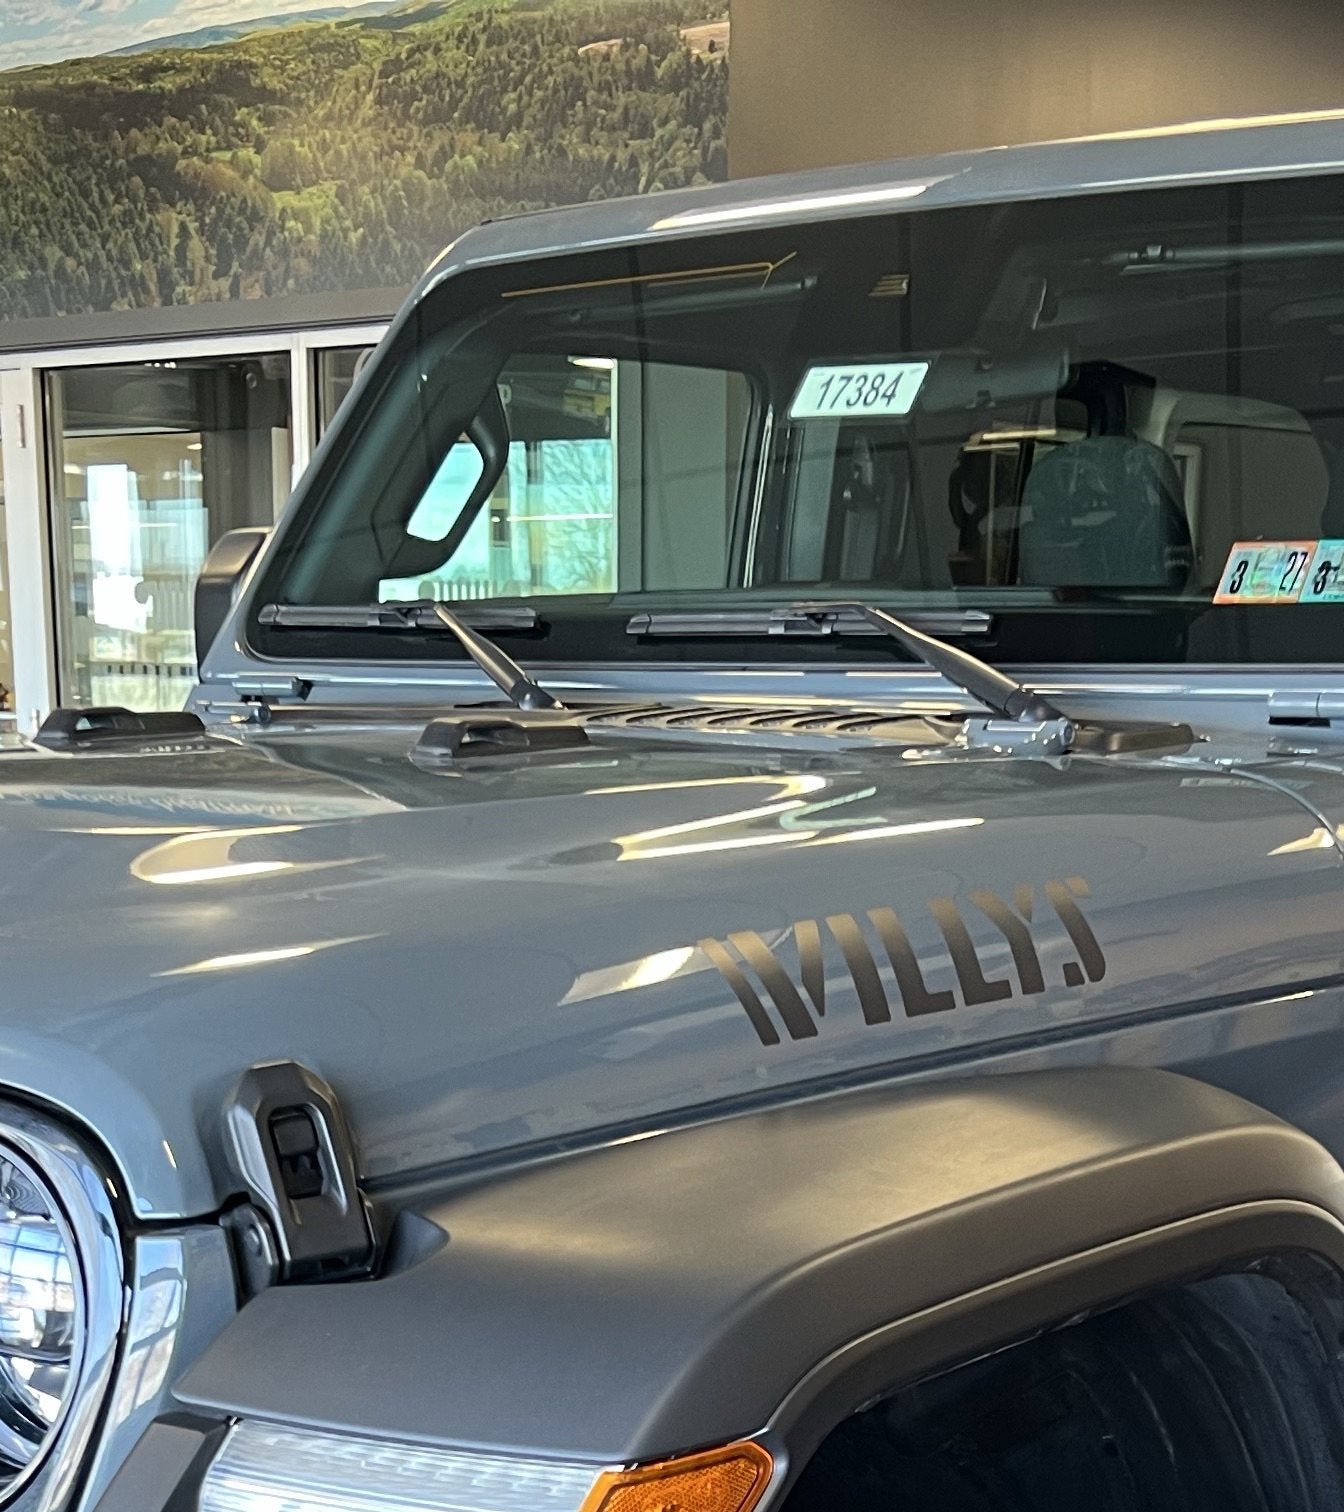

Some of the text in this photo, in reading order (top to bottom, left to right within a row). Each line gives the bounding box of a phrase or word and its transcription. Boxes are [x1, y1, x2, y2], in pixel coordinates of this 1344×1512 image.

[816, 370, 905, 410] 17384
[1278, 550, 1309, 594] 27
[697, 875, 1107, 1047] WILLYS
